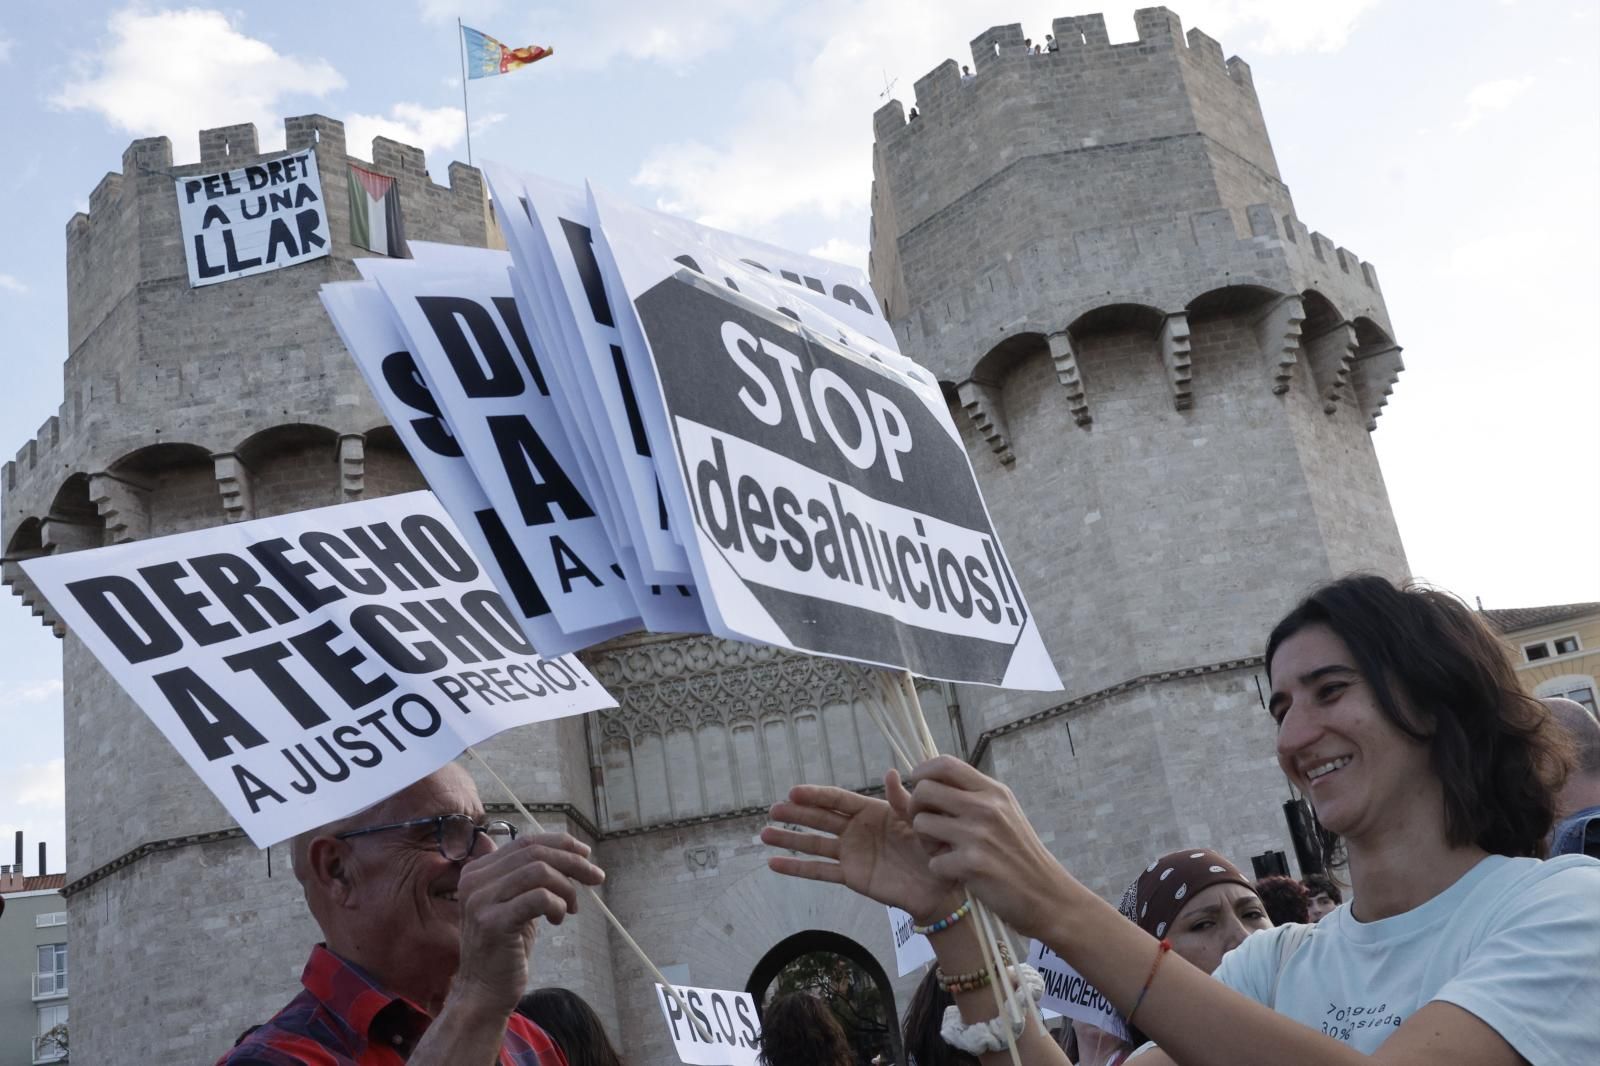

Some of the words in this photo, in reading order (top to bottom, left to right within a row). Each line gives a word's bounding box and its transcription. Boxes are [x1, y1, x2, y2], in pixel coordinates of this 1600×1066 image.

[185, 172, 240, 204] PEL
[245, 155, 309, 190] DRET
[194, 208, 326, 278] LLAR
[202, 204, 231, 229] A
[240, 183, 319, 220] UNA
[720, 320, 913, 483] STOP
[65, 514, 479, 665] DERECHO
[696, 436, 1020, 627] desahucios!
[152, 666, 270, 762] A
[222, 589, 538, 730] TECHO
[231, 764, 288, 814] A
[288, 692, 443, 794] JUSTO
[432, 656, 589, 714] PRECIO!
